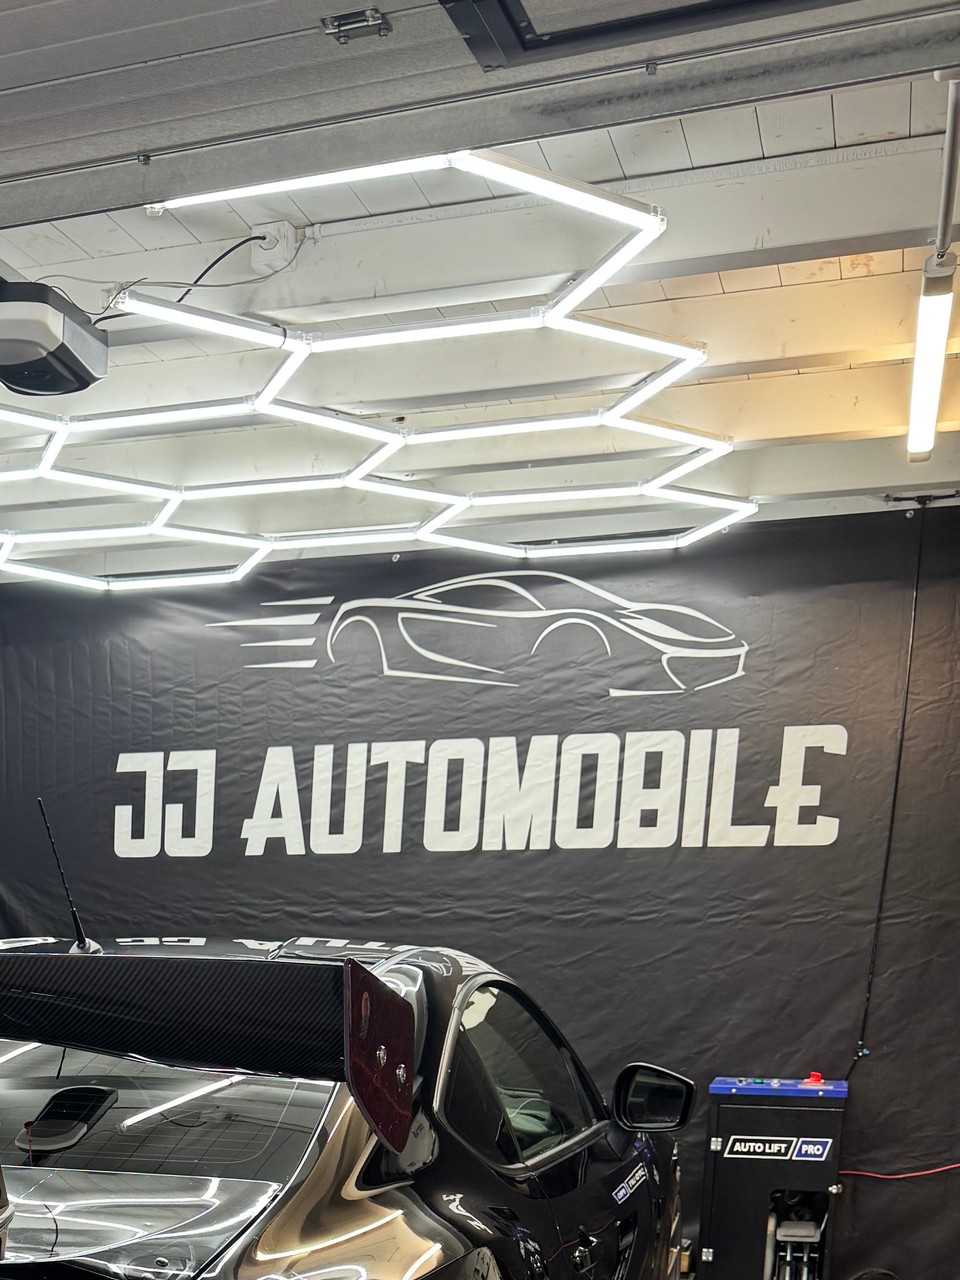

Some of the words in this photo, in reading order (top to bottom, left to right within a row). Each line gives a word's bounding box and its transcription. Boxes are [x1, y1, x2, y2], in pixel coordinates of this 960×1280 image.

[113, 749, 217, 859] JJ
[240, 724, 848, 857] AUTOMOBILE
[733, 1142, 765, 1153] AUTO
[765, 1143, 788, 1154] LIFT
[801, 1144, 823, 1155] PRO
